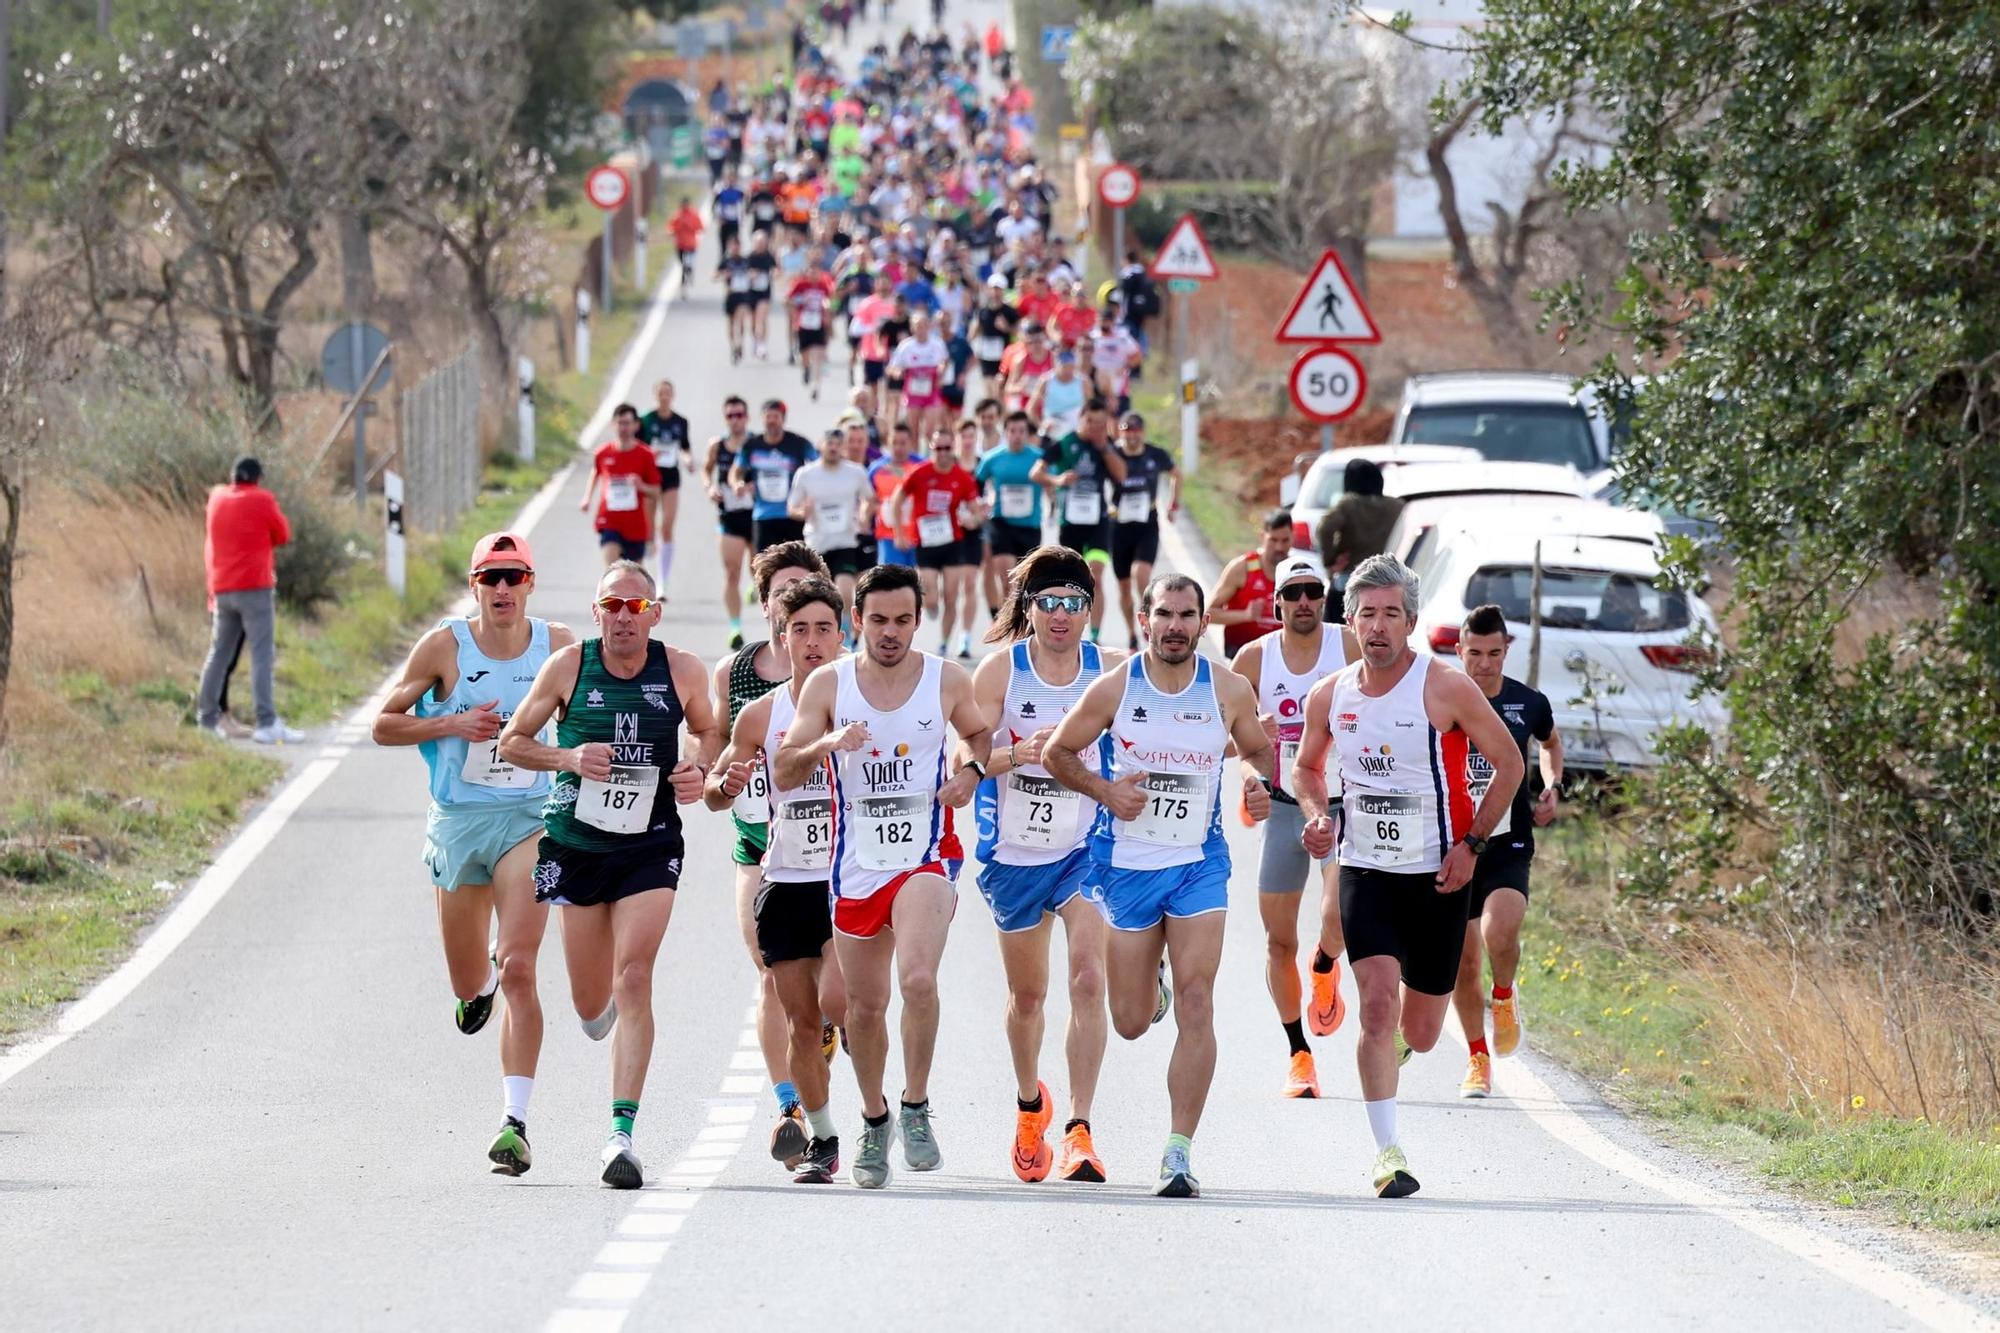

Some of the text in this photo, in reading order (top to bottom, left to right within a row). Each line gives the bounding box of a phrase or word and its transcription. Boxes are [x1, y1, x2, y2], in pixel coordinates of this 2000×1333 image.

[1310, 373, 1349, 396] 50
[877, 783, 906, 792] IBIZA
[601, 788, 640, 811] 187
[1151, 796, 1189, 820] 175
[1029, 801, 1053, 823] 73
[807, 822, 829, 844] 81
[875, 821, 913, 844] 182
[1376, 820, 1400, 841] 66
